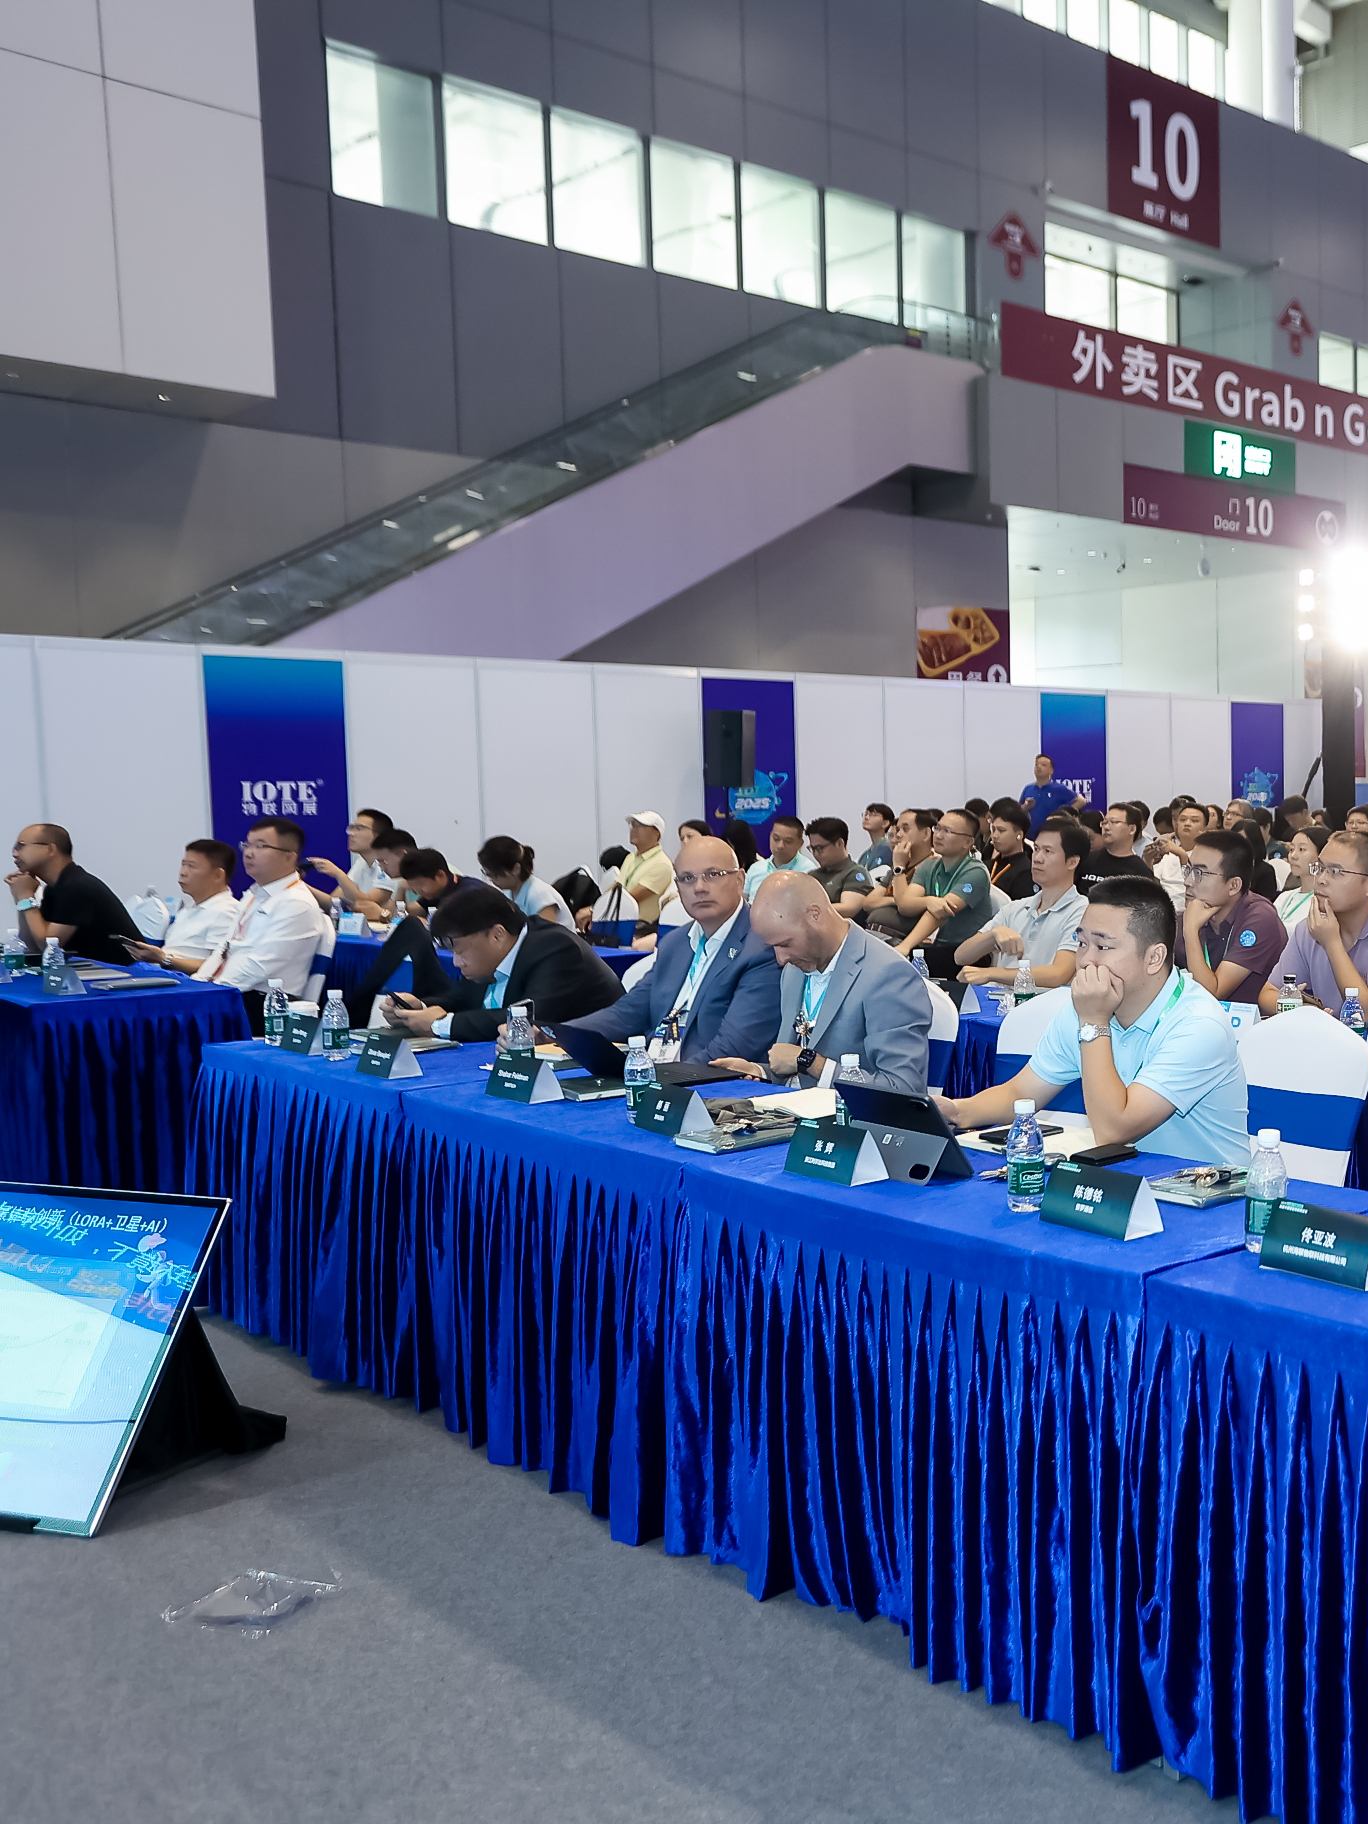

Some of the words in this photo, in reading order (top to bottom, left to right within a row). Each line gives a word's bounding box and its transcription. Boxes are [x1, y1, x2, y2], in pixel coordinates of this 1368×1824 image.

[1129, 98, 1200, 202] 10
[1071, 329, 1204, 411] 外卖区
[1214, 370, 1305, 432] Grab
[1314, 402, 1335, 439] n
[1130, 496, 1145, 519] 10
[1245, 496, 1274, 537] 10
[1213, 514, 1240, 532] Door
[240, 780, 318, 802] IOTE
[1056, 779, 1092, 793] OTE
